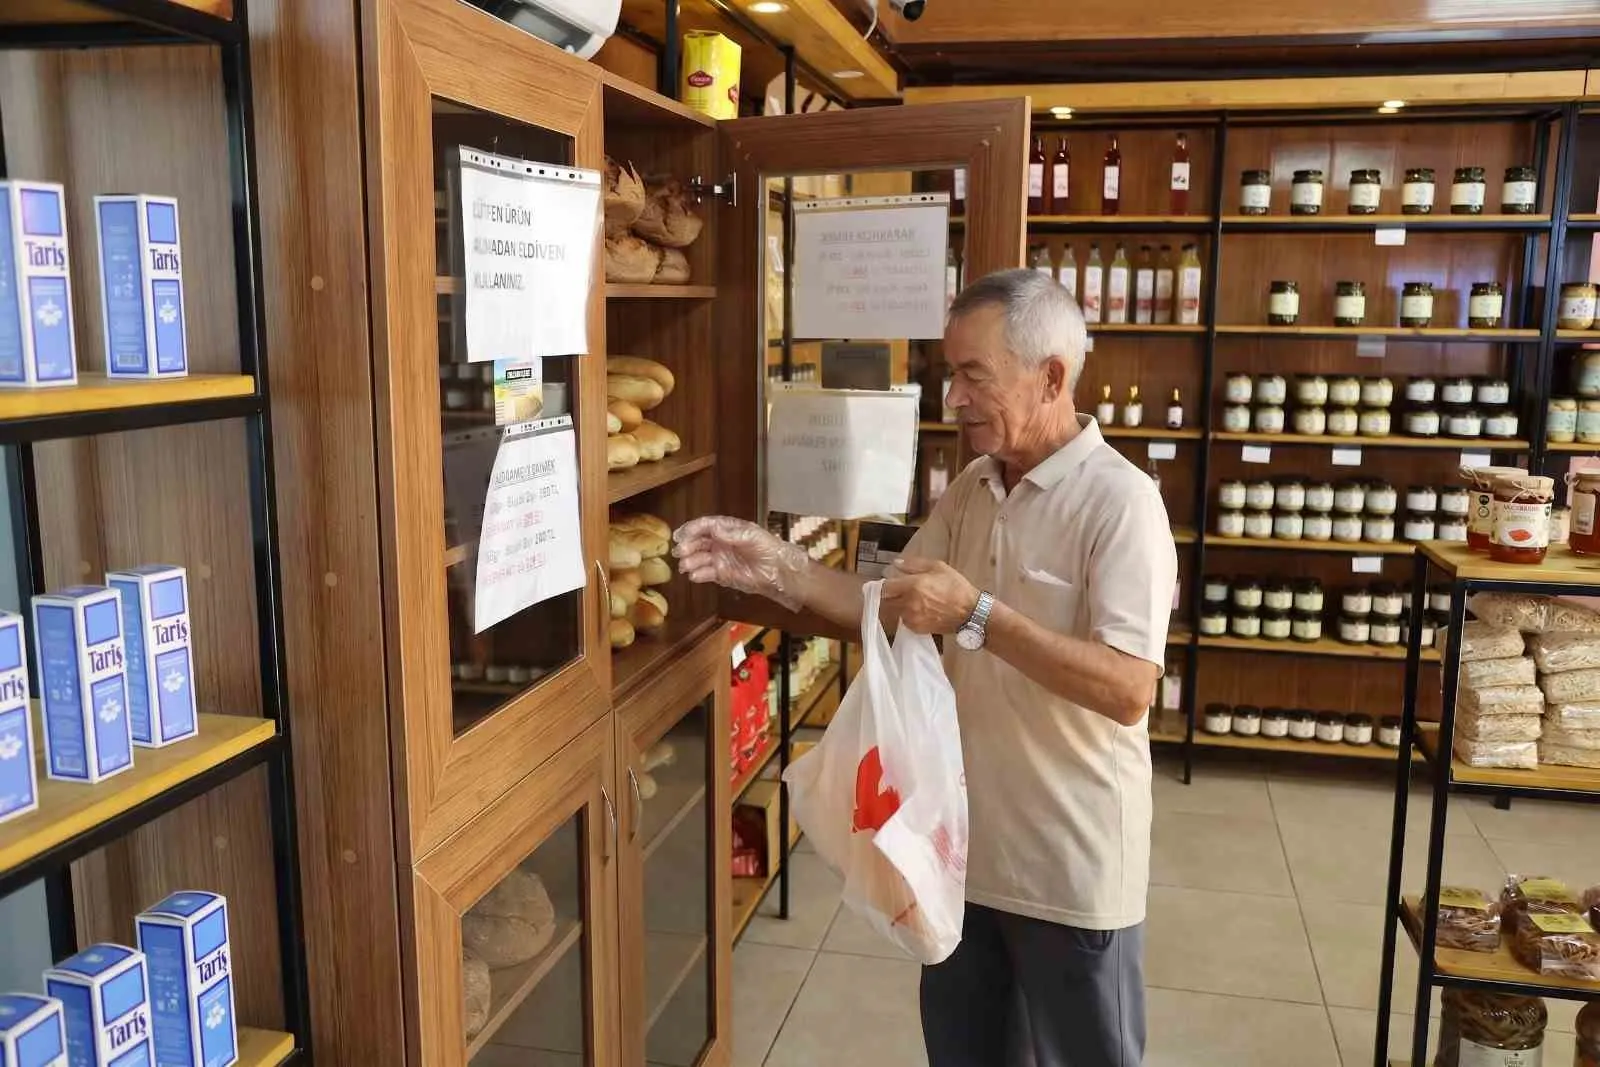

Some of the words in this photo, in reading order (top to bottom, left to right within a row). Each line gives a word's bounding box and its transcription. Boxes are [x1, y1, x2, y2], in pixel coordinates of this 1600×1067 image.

[505, 202, 531, 227] ÜRÜN
[24, 241, 65, 271] Tariş
[150, 248, 179, 274] Tariş
[518, 240, 565, 261] ELDİVEN
[152, 619, 188, 646] Tariş
[88, 643, 123, 674] Tariş
[0, 674, 25, 701] riş
[196, 949, 228, 984] Tariş
[105, 1010, 147, 1049] Tariş
